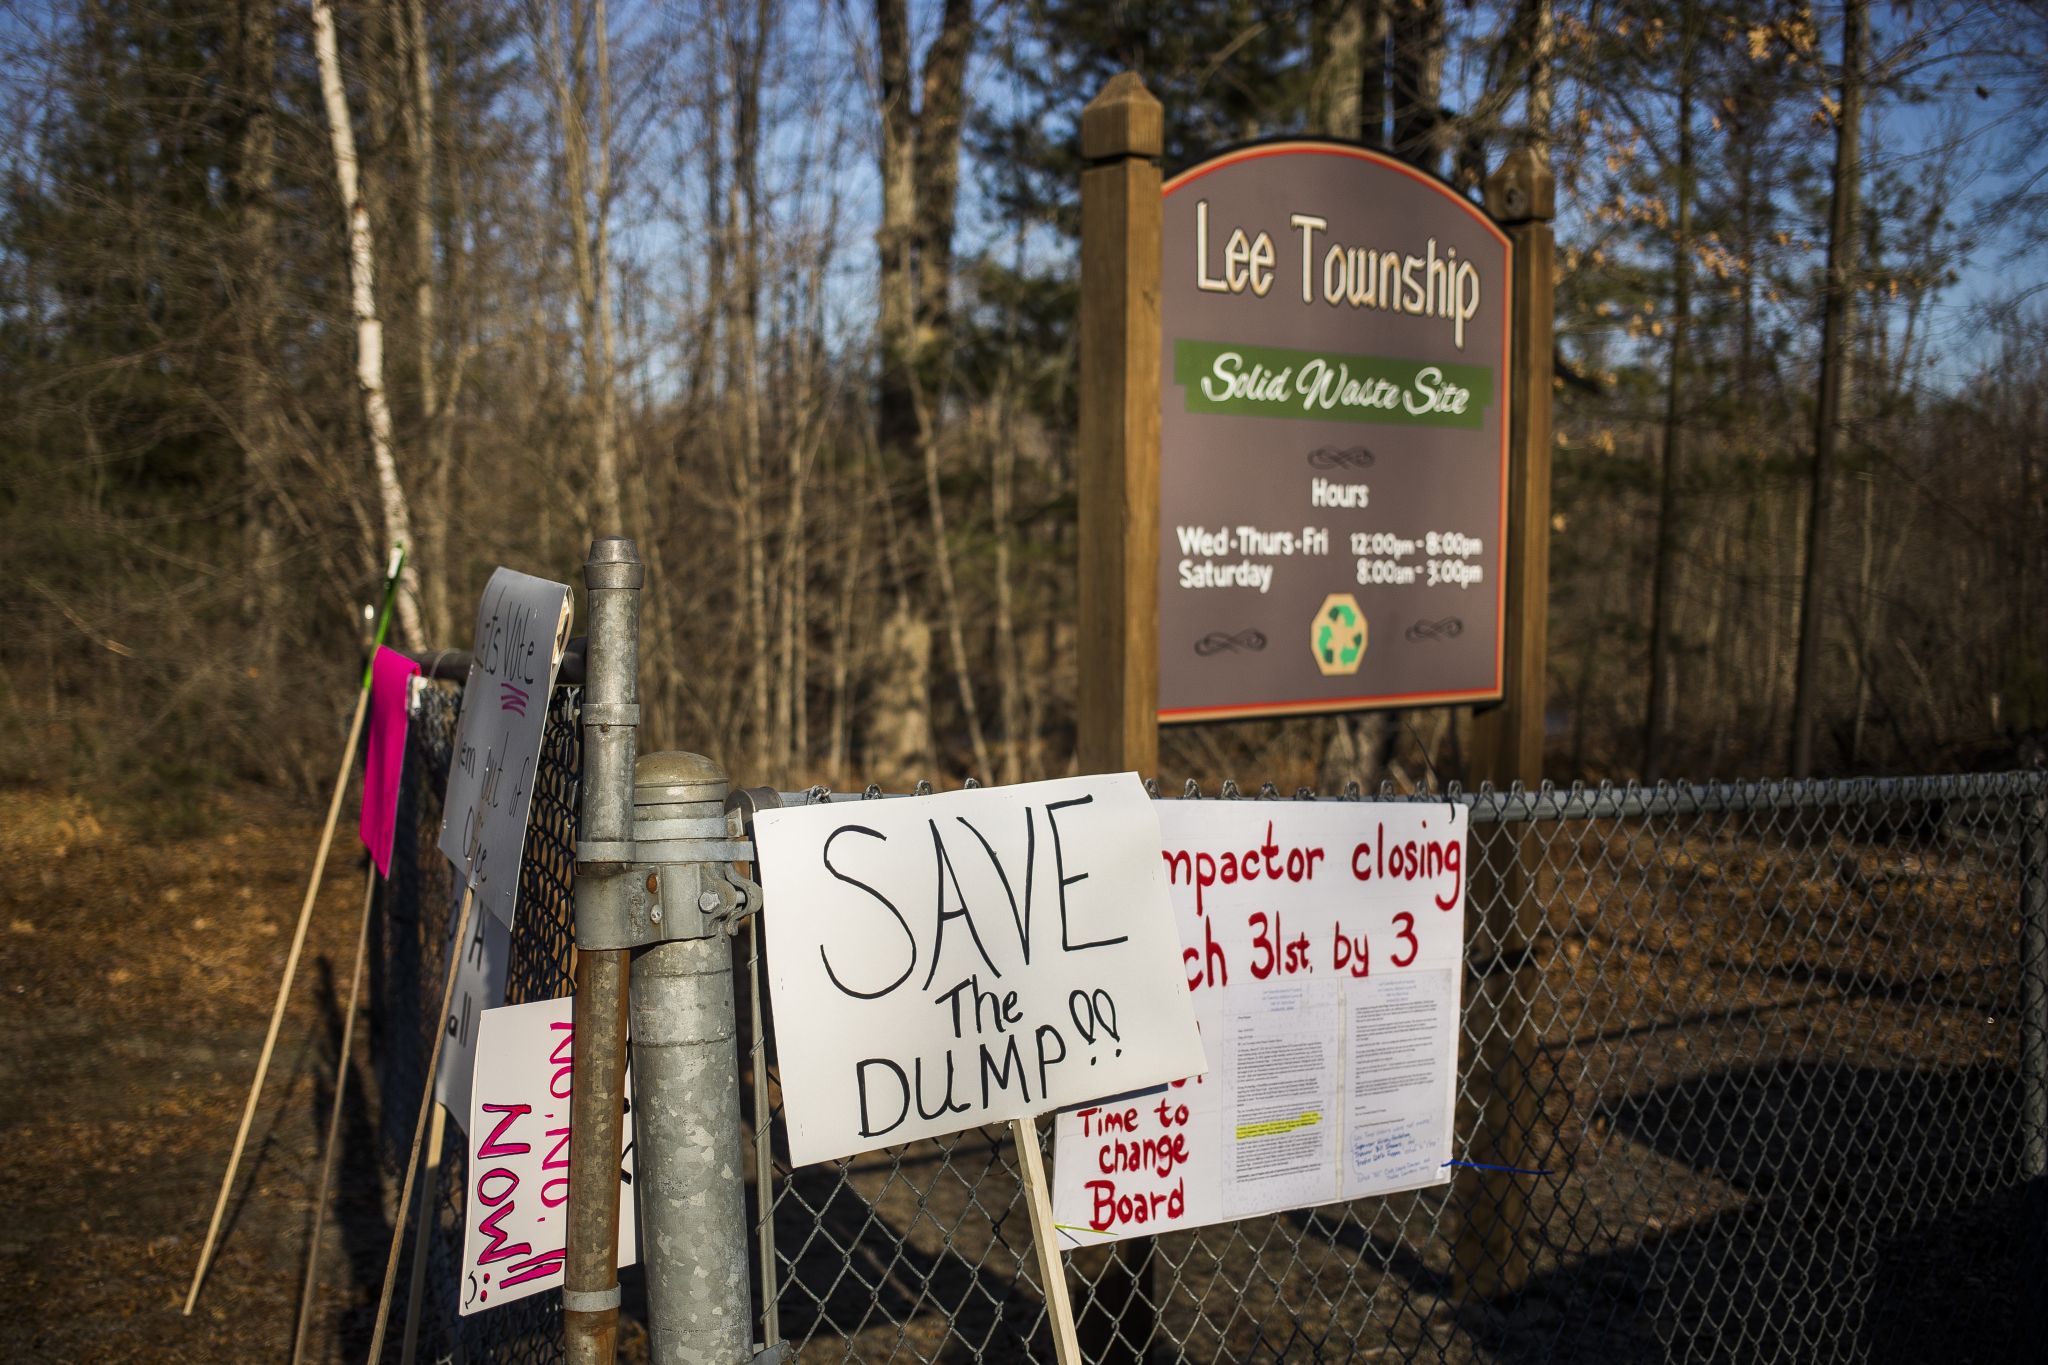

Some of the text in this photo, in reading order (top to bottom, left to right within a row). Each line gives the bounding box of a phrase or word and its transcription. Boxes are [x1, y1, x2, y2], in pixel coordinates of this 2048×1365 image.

[1196, 200, 1481, 351] Lee Township
[1200, 352, 1471, 416] Solid Waste Site
[1311, 477, 1370, 508] Hours
[1178, 559, 1274, 594] Saturday
[820, 794, 1129, 1000] SAVE
[1162, 820, 1462, 917] mpactor closing
[1183, 914, 1228, 992] ch
[1333, 920, 1369, 978] by
[1390, 910, 1419, 968] 3
[935, 974, 1024, 1038] The
[1077, 1097, 1190, 1138] Time to
[1099, 1133, 1190, 1178] change
[1084, 1177, 1185, 1232] Board
